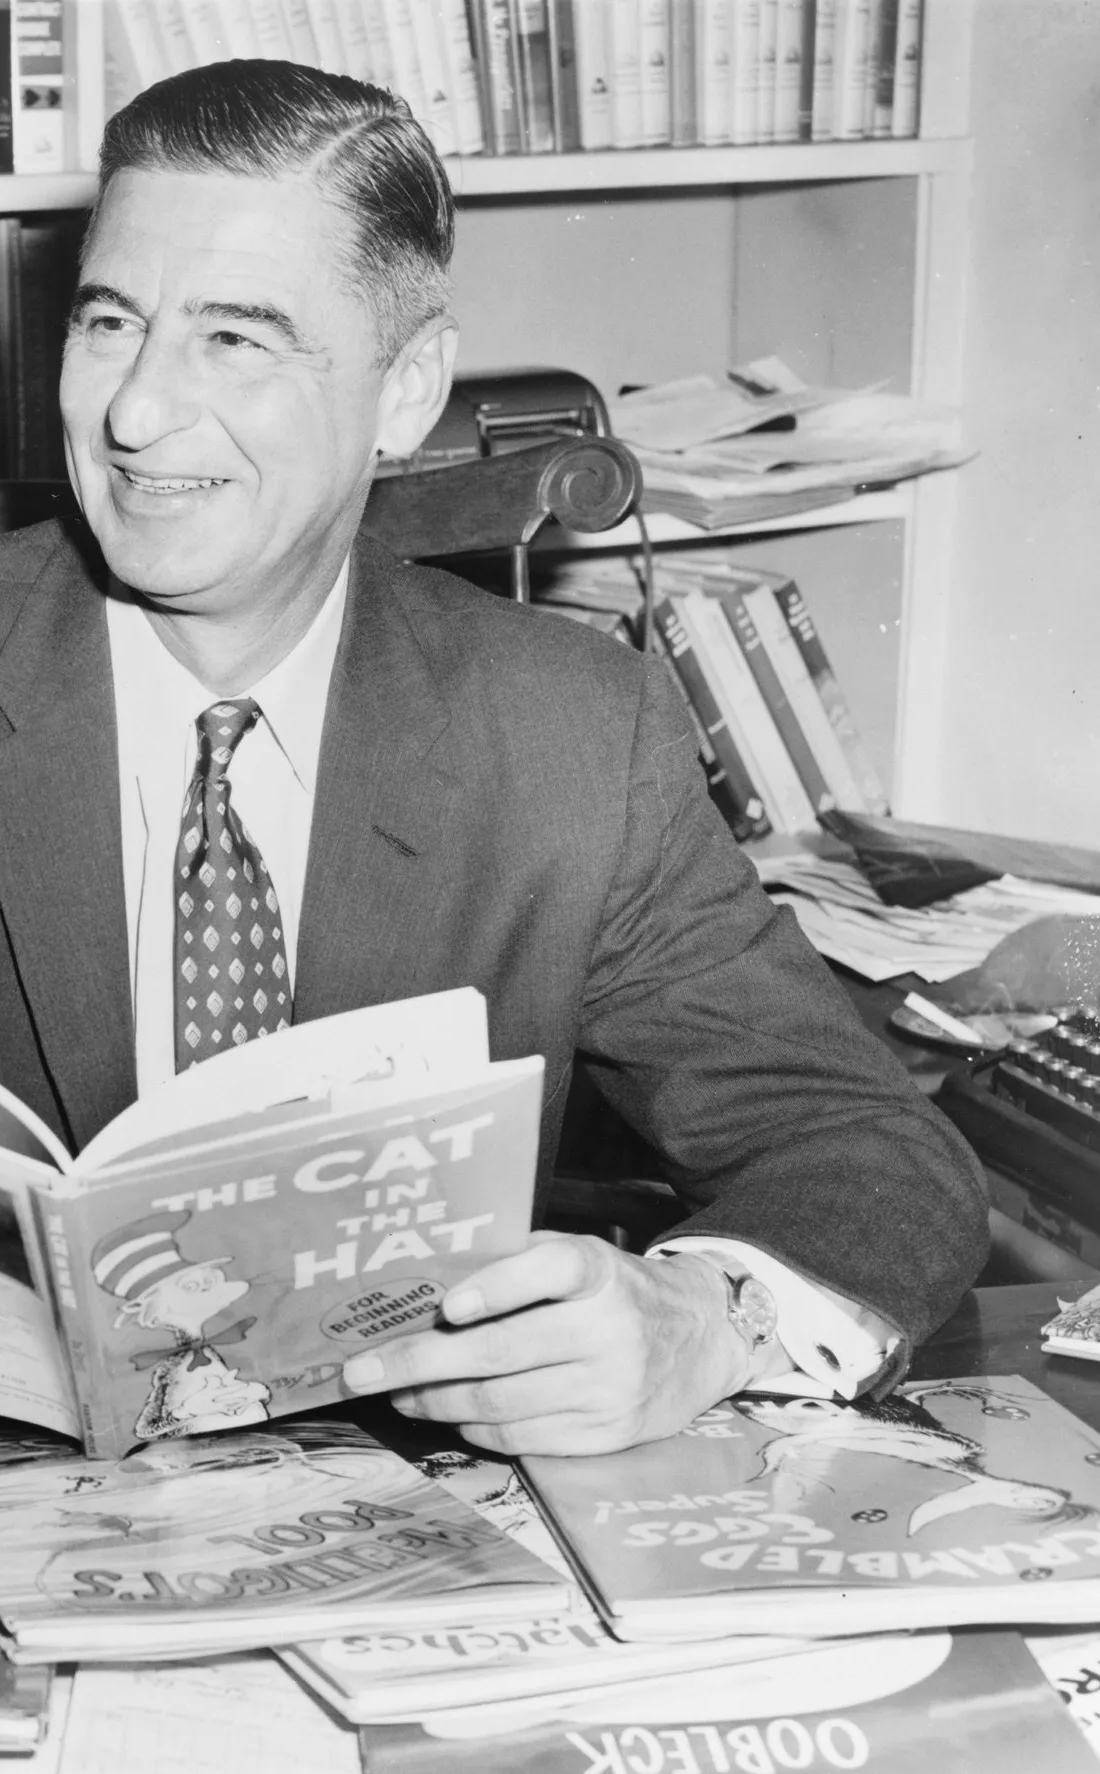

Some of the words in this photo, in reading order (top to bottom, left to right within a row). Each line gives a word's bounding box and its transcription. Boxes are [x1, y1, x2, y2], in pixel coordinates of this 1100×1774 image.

[151, 1175, 278, 1212] THE
[293, 1112, 495, 1193] CAT
[365, 1177, 429, 1208] IN
[336, 1200, 448, 1235] THE
[293, 1213, 495, 1290] HAT
[328, 1283, 436, 1336] BEGINNING
[347, 1290, 390, 1315] FOR
[360, 1299, 441, 1341] READERS
[206, 1499, 415, 1556] POOL
[623, 1512, 836, 1548] EGGS
[565, 1717, 870, 1774] OOBLECK
